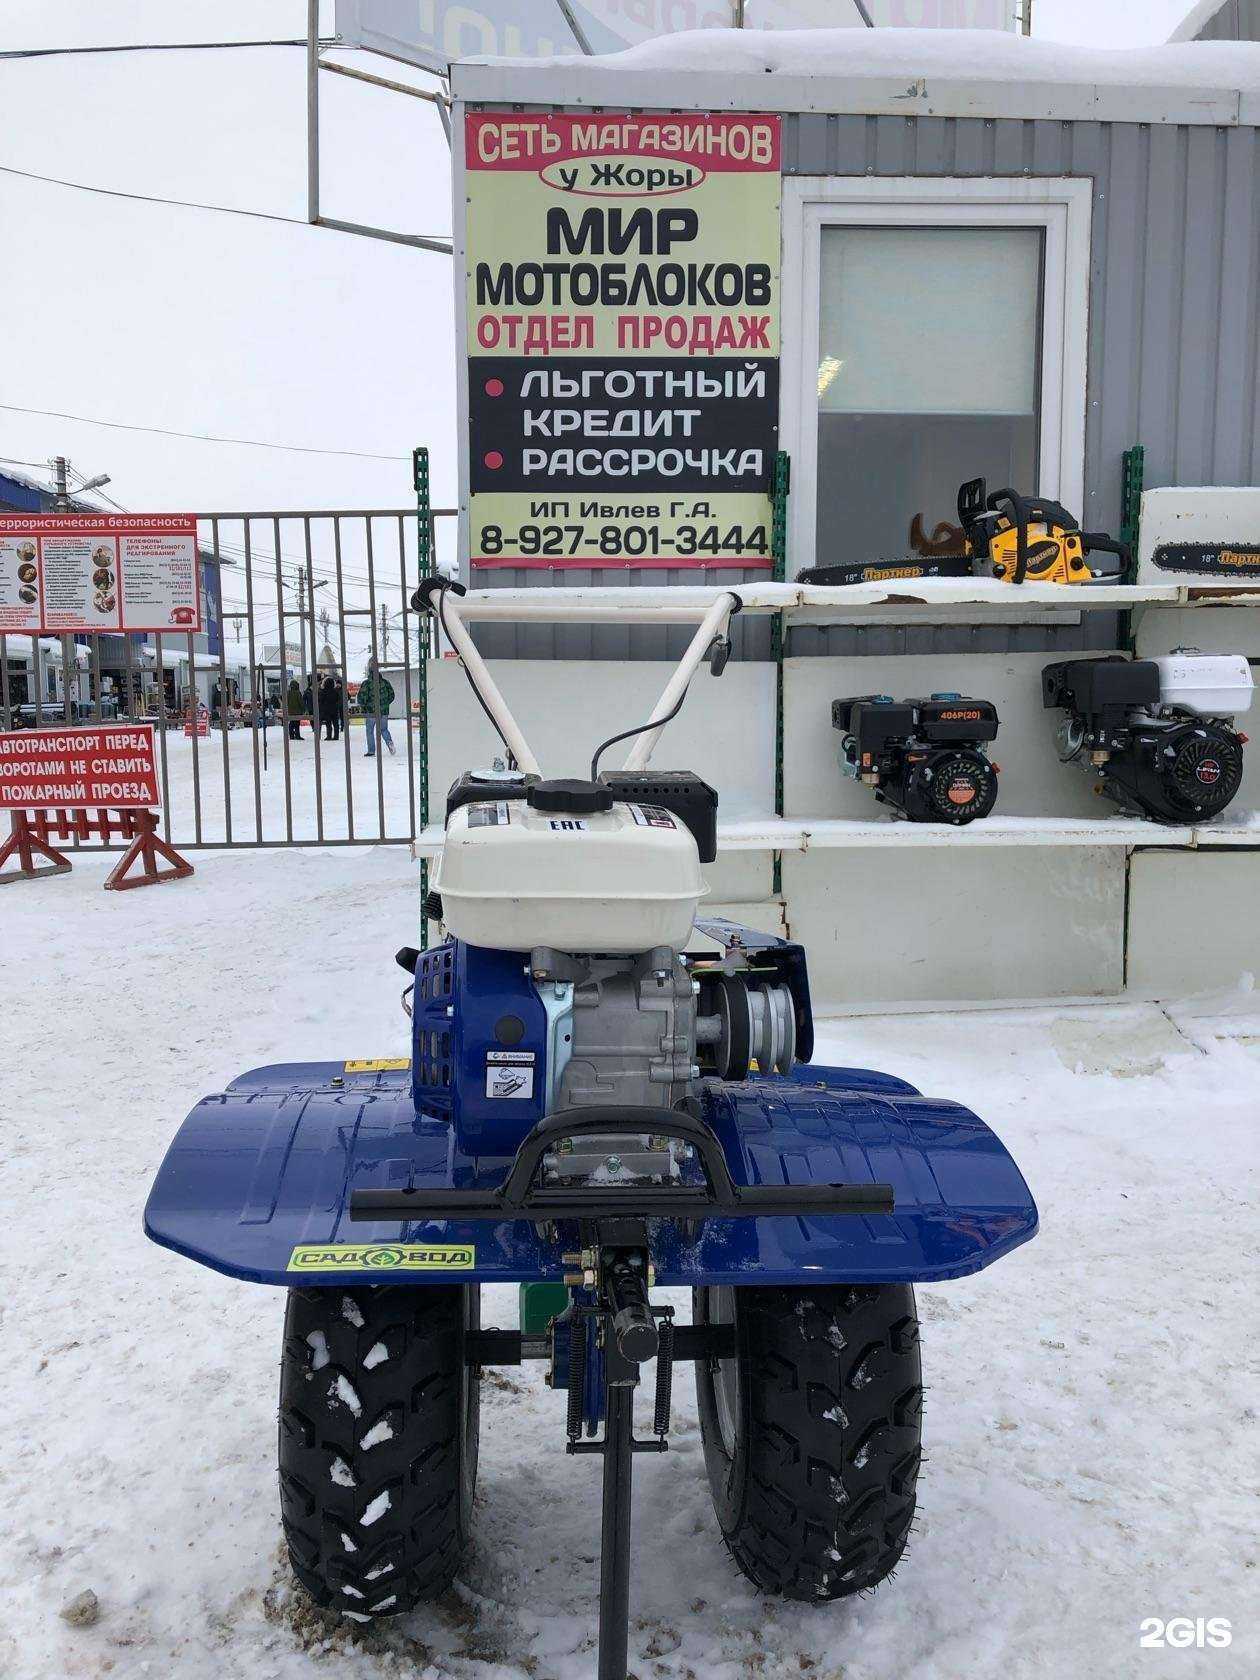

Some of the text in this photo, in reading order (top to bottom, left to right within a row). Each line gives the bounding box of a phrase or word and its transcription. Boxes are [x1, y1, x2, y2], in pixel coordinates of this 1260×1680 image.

[478, 123, 773, 164] СЕТЬ МАГАЗИНОВ
[559, 163, 693, 191] у Жоры
[546, 207, 699, 255] МИР
[476, 262, 772, 307] МОТОБЛОКОВ
[477, 315, 771, 355] ОТДЕЛ ПРОДАЖ
[519, 362, 766, 398] ЛЬГОТНЫЙ
[523, 409, 702, 437] КРЕДИТ
[522, 448, 763, 476] РАССРОЧКА
[108, 517, 191, 528] безопасность
[530, 501, 717, 518] ИП Ивлев Г.А.
[480, 525, 769, 555] 8-927-801-3444
[105, 733, 149, 751] ПЕРЕД
[70, 760, 87, 775] НЕ
[91, 757, 152, 774] СТАВИТЬ
[2, 780, 152, 801] ПОЖАРНЫЙ ПРОЕЗД
